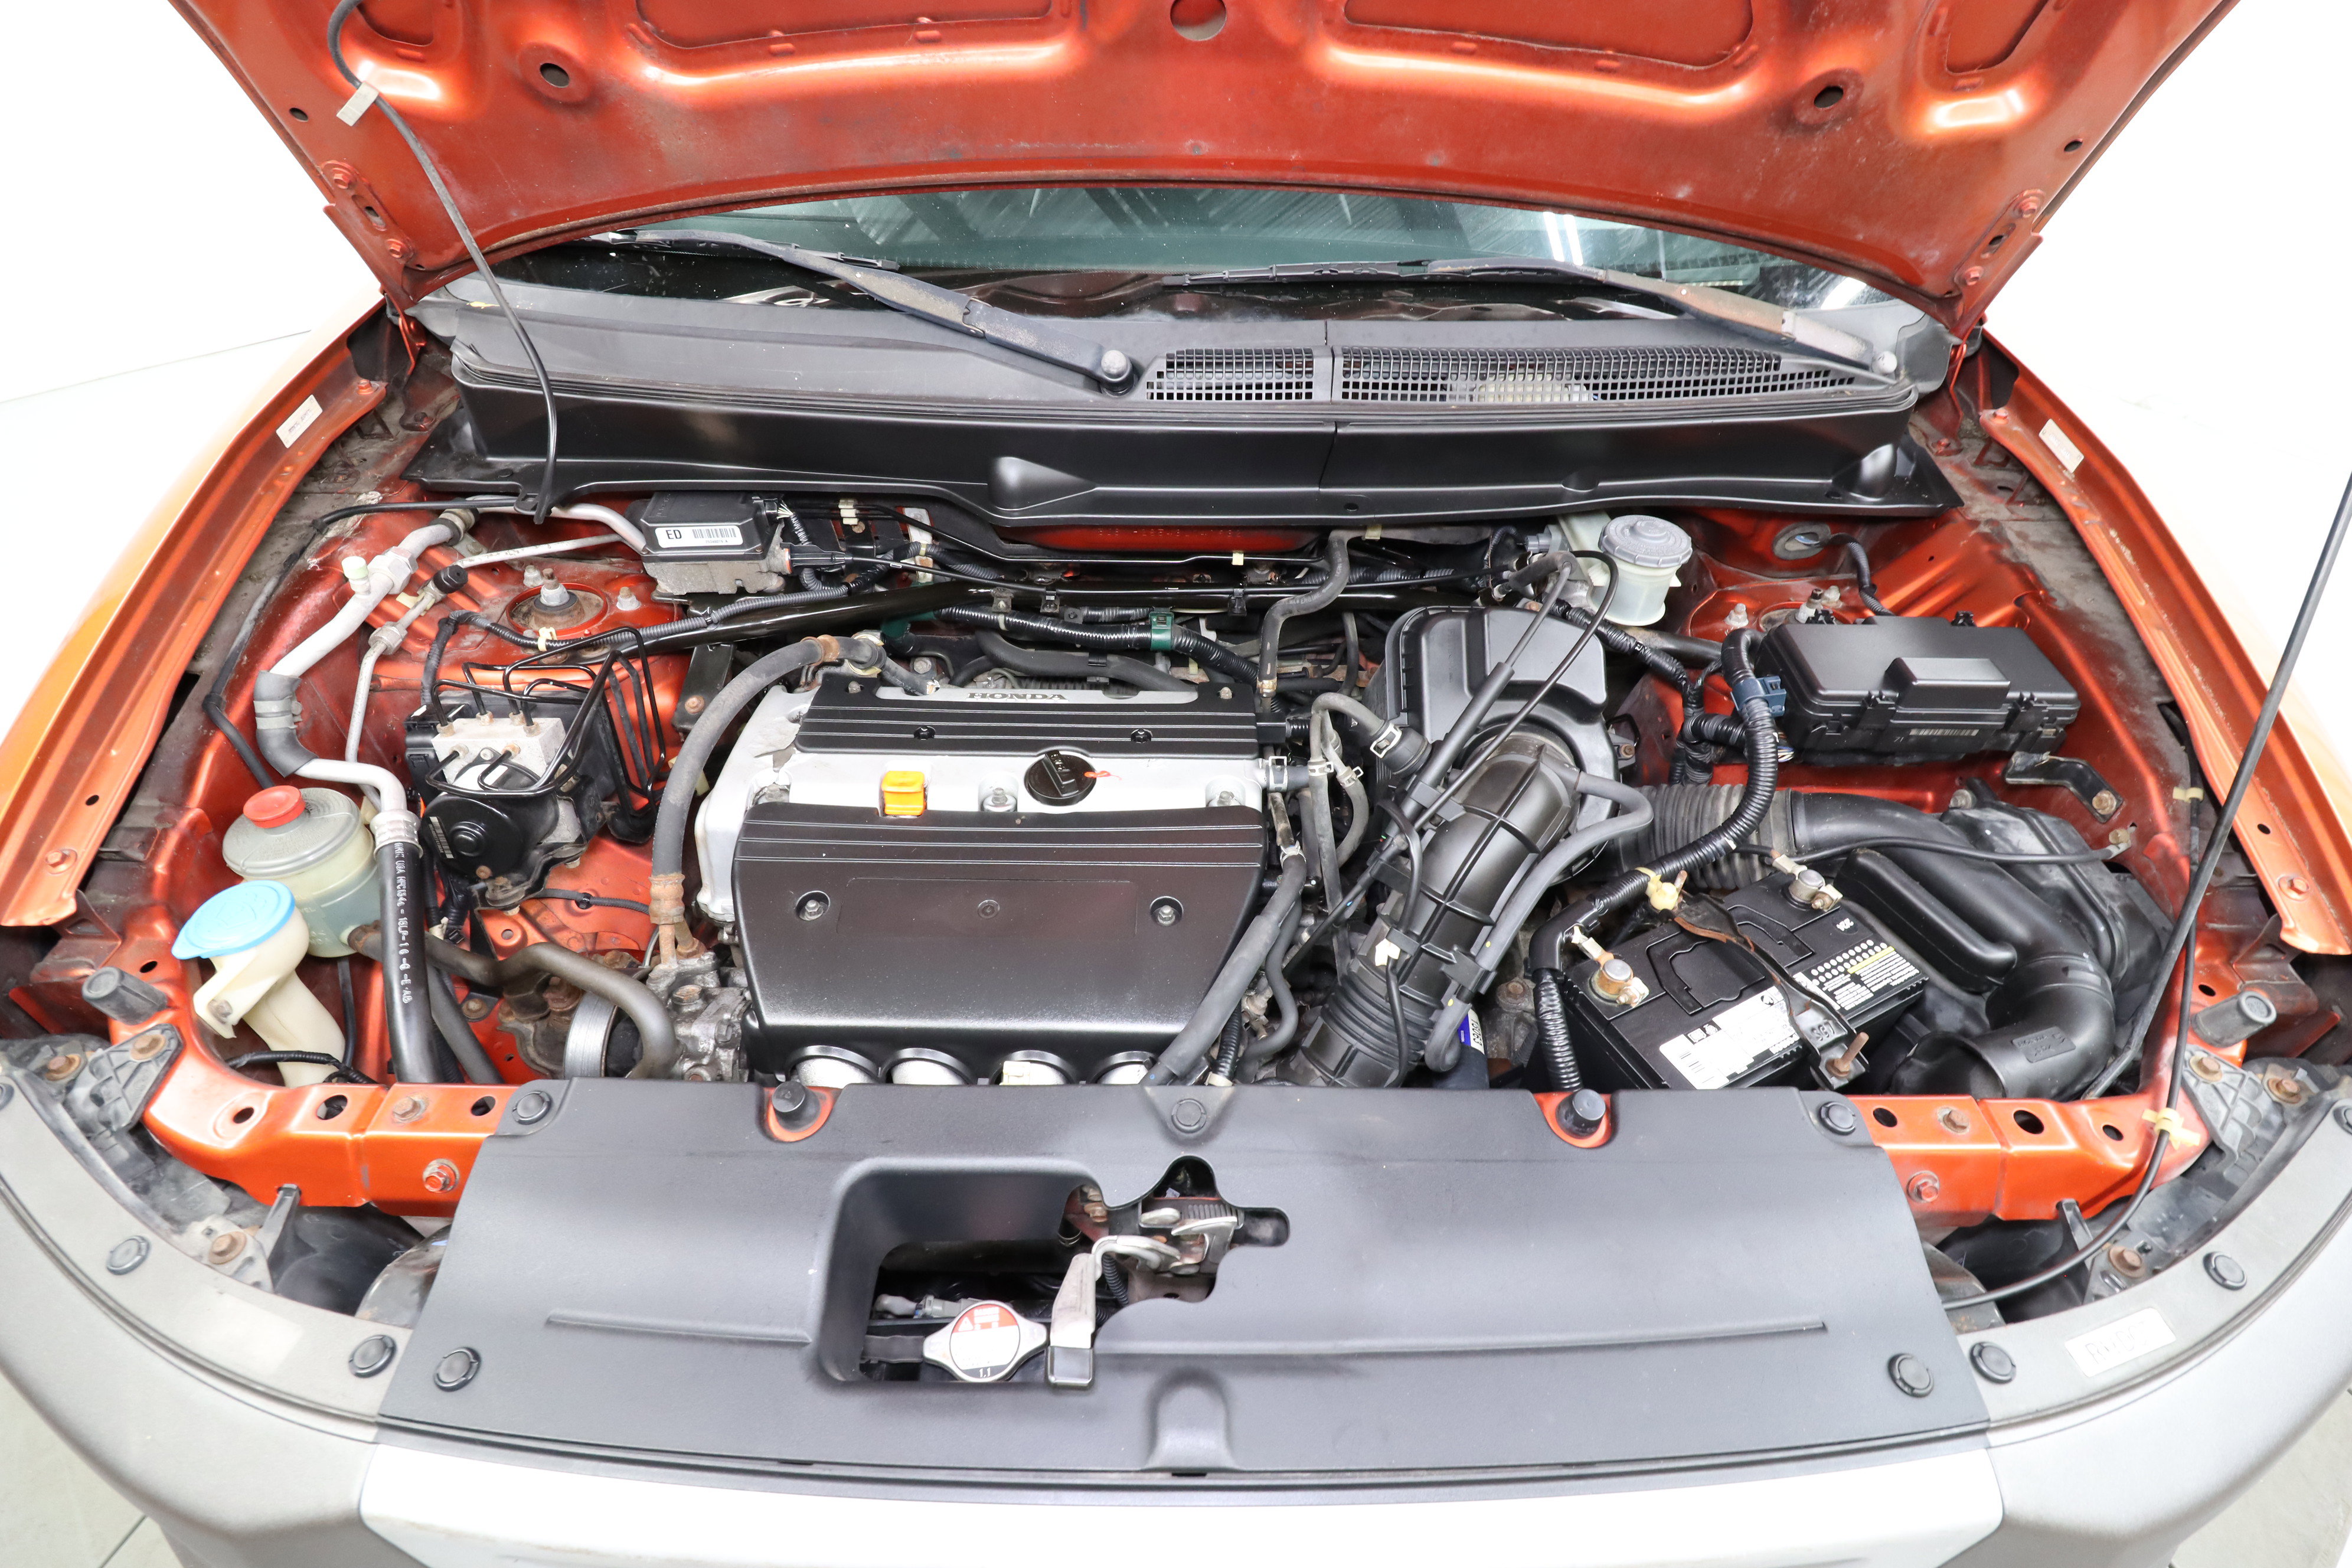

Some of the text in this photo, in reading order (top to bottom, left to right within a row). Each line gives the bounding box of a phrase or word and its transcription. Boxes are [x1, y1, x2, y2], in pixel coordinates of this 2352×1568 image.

[666, 529, 682, 540] ED
[966, 692, 1068, 701] HONDA
[1471, 1019, 1482, 1046] 15063
[979, 1367, 991, 1378] 1.1
